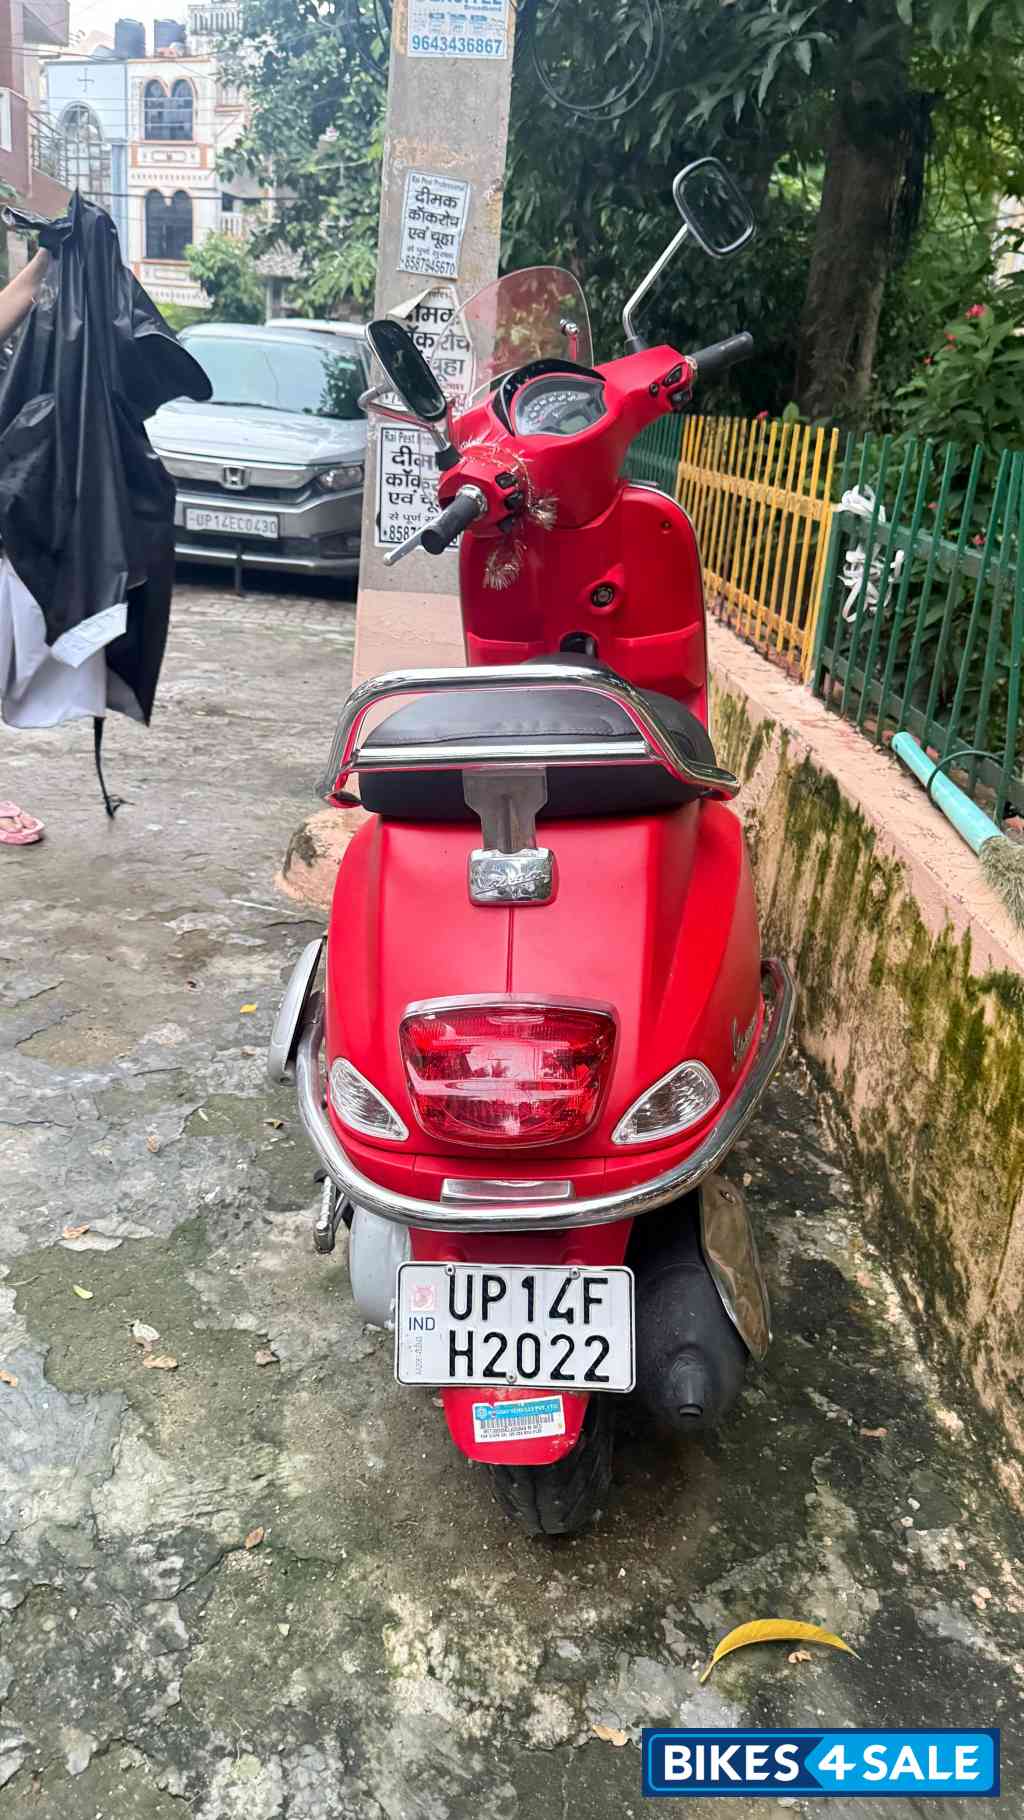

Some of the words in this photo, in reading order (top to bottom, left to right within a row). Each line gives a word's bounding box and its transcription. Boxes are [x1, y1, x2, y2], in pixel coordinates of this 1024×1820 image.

[412, 34, 503, 54] 9643436867
[414, 186, 460, 208] दीमक
[408, 226, 430, 240] एवं
[430, 230, 456, 249] चूहा
[388, 488, 417, 504] एवं
[196, 514, 277, 534] UP14EC0430
[449, 1273, 609, 1325] UP14F
[408, 1316, 436, 1331] IND
[449, 1330, 610, 1383] H2022
